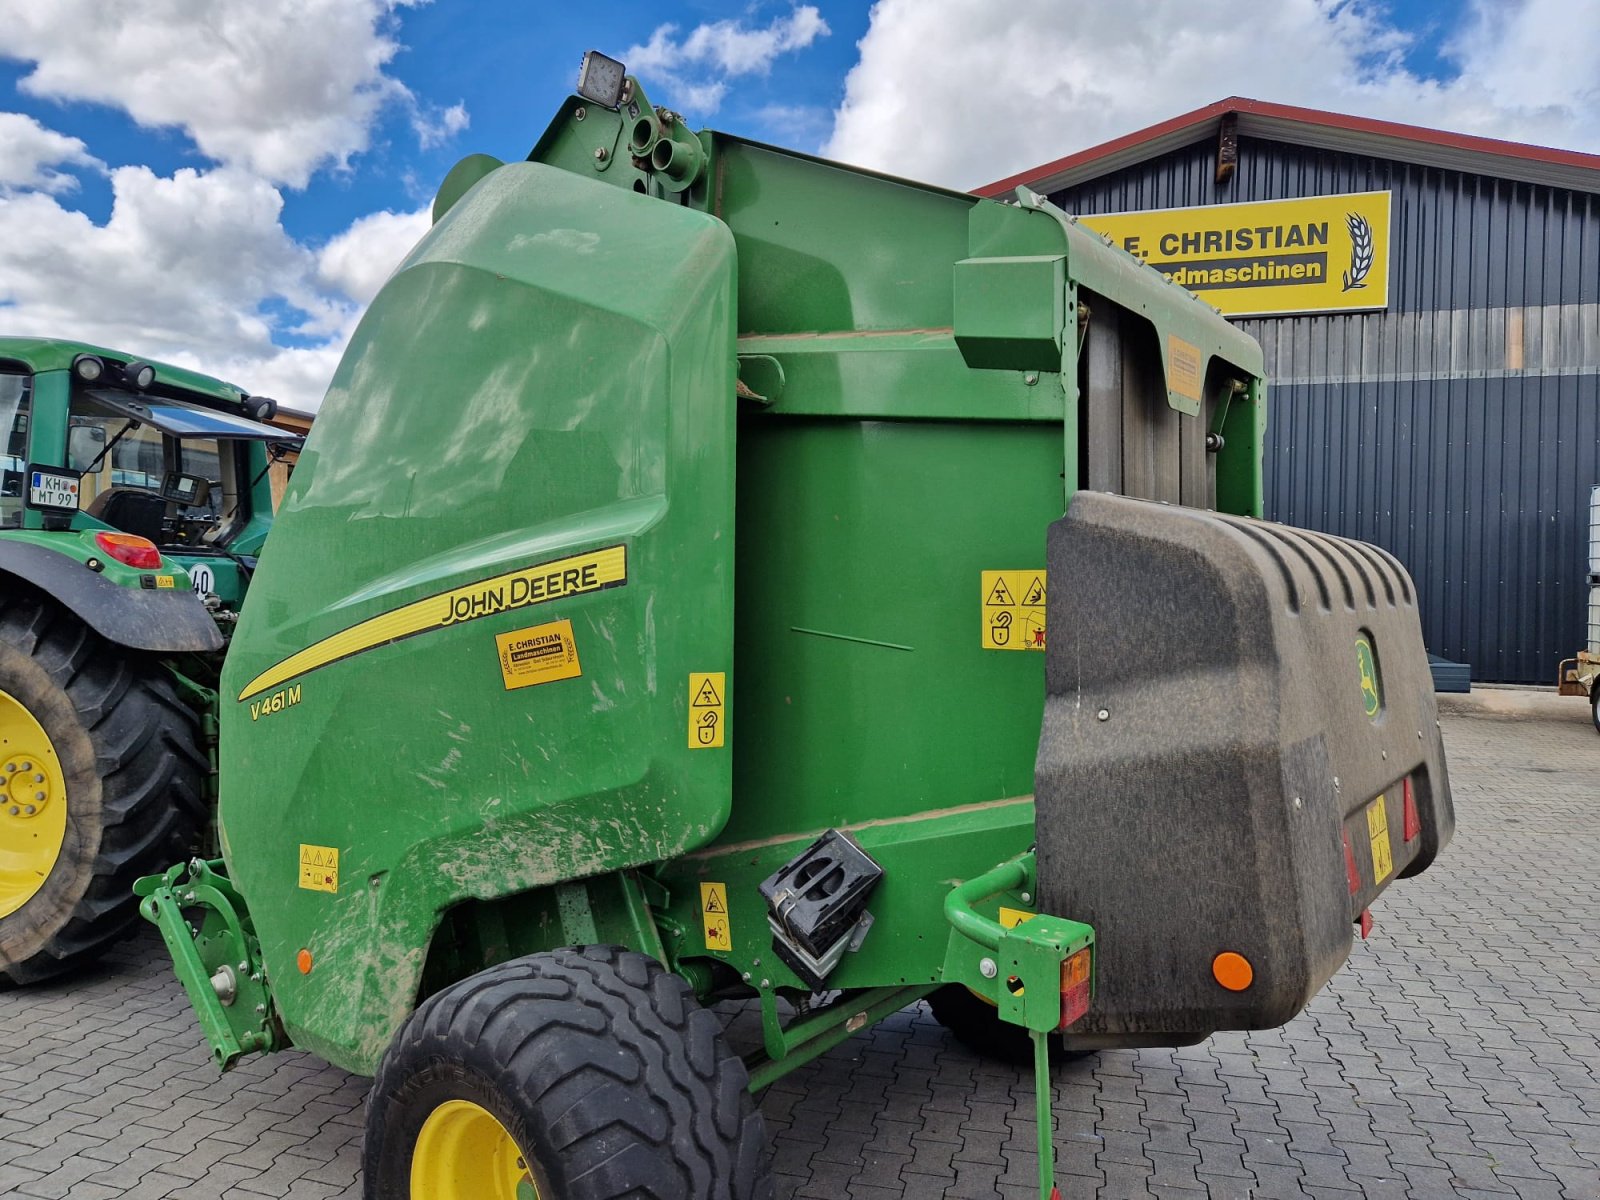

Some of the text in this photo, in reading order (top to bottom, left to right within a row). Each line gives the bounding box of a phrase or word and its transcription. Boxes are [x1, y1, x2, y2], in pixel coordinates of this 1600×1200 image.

[1124, 222, 1329, 257] E. CHRISTIAN
[45, 477, 61, 491] KH
[38, 490, 72, 506] MT 99
[192, 570, 209, 595] 40
[442, 564, 598, 622] JOHN DEERE
[513, 645, 561, 661] Landmaschinen
[250, 683, 302, 721] V 461 M
